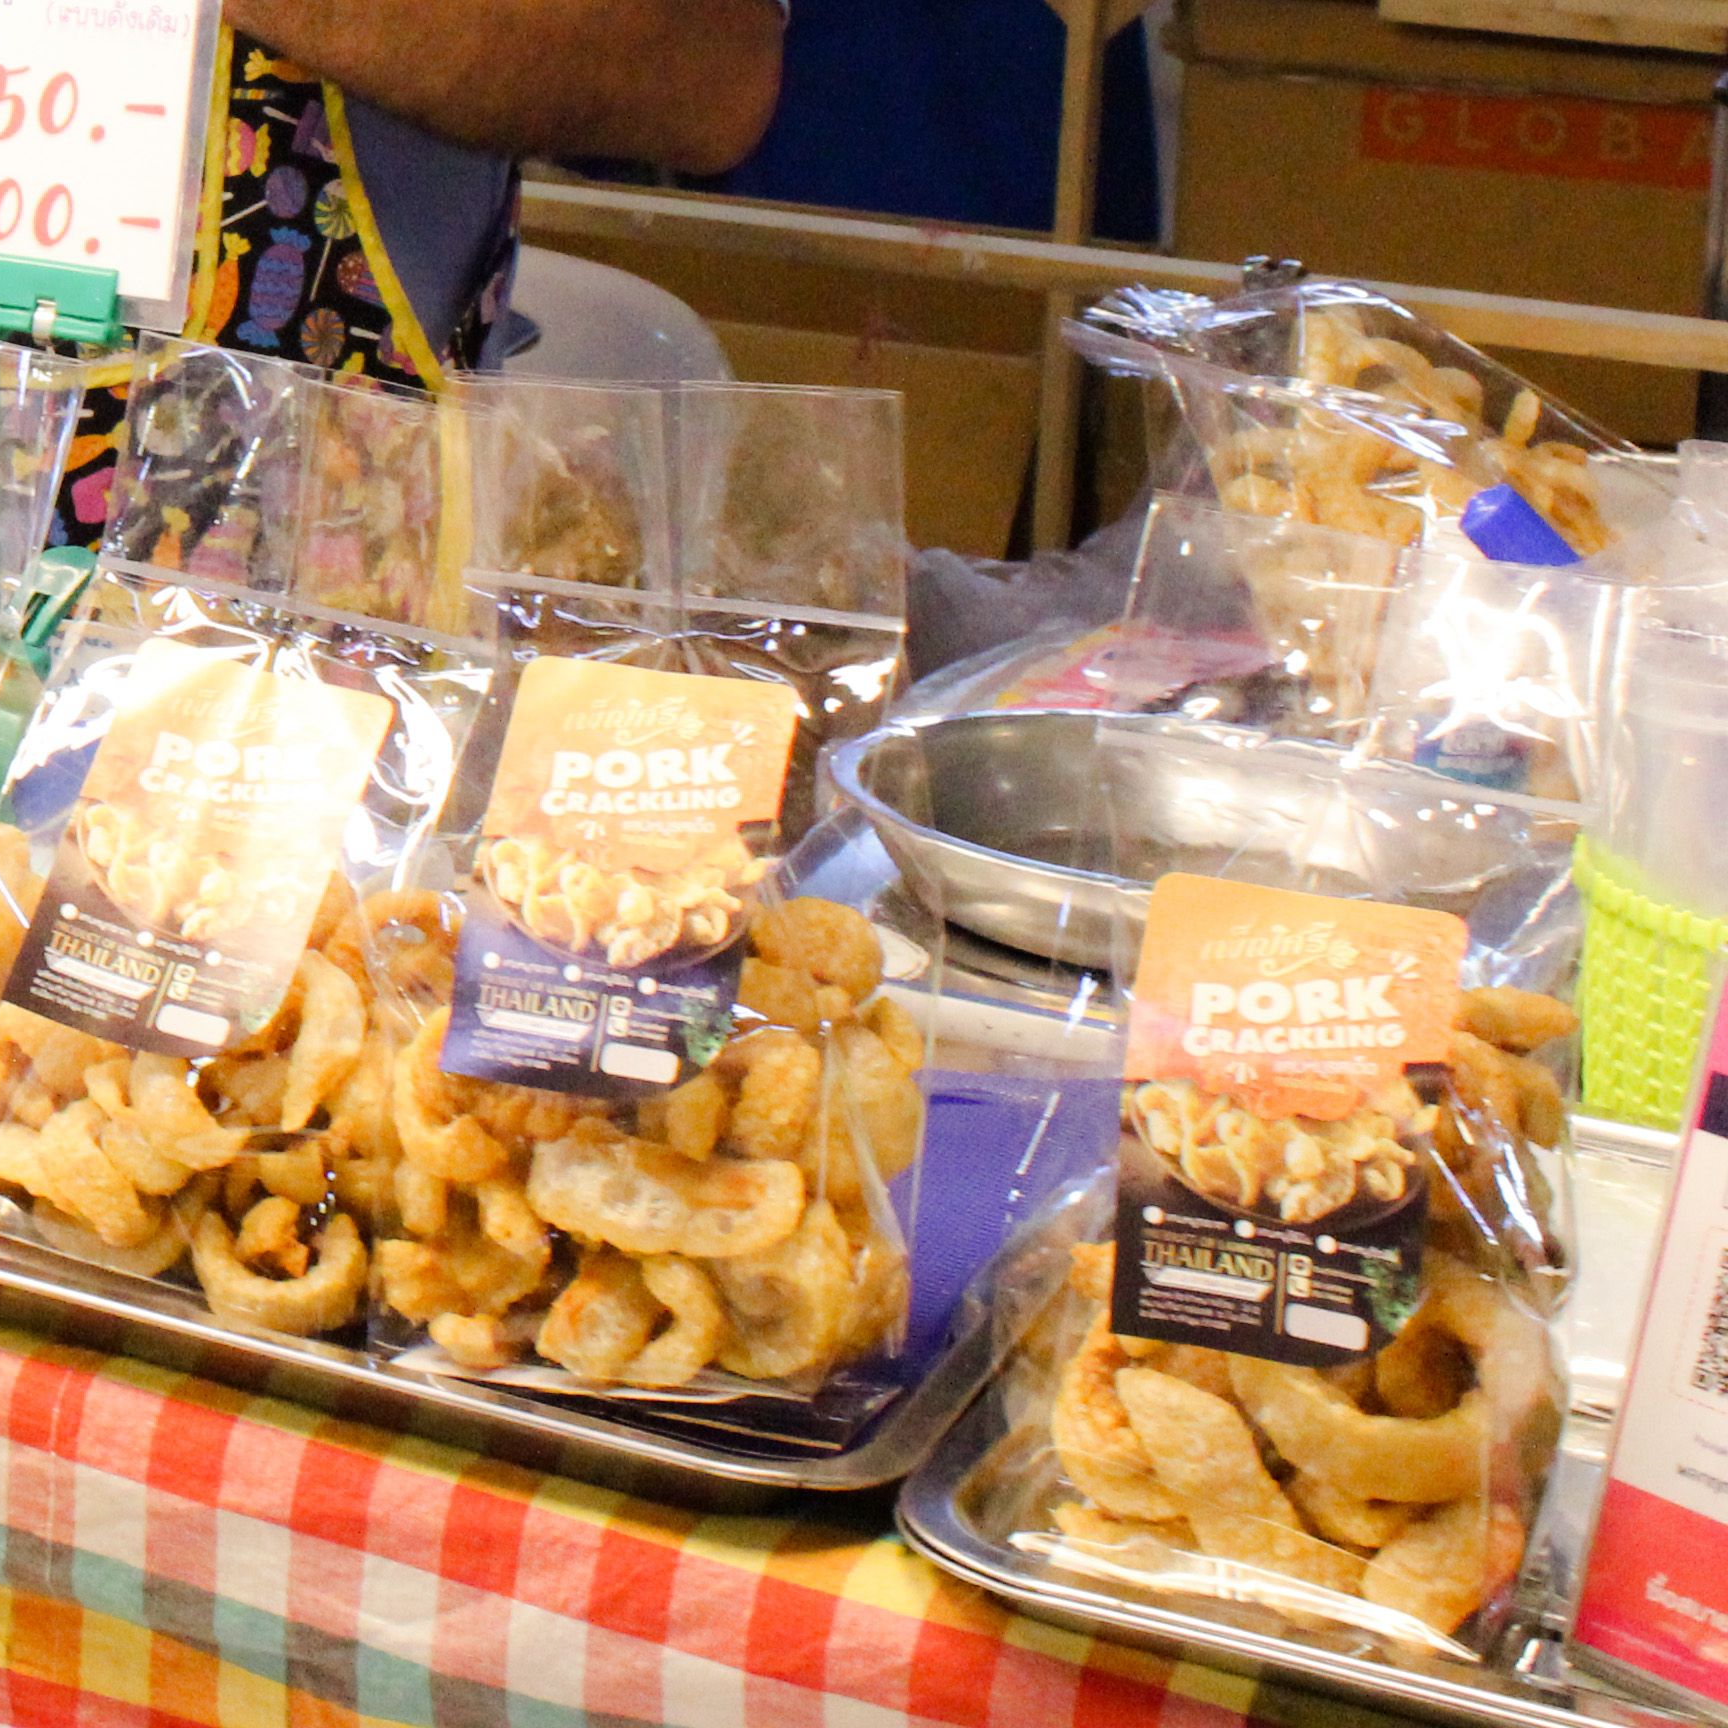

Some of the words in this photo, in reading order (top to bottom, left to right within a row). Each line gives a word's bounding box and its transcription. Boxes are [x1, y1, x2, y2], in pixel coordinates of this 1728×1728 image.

[551, 742, 739, 790] PORK
[540, 786, 742, 816] CRACKLING
[48, 929, 163, 986] THAILAND
[478, 983, 597, 1023] THAILAND
[1190, 973, 1401, 1026] PORK
[1181, 1022, 1408, 1056] CRACKLING
[1144, 1239, 1276, 1281] THAILAND
